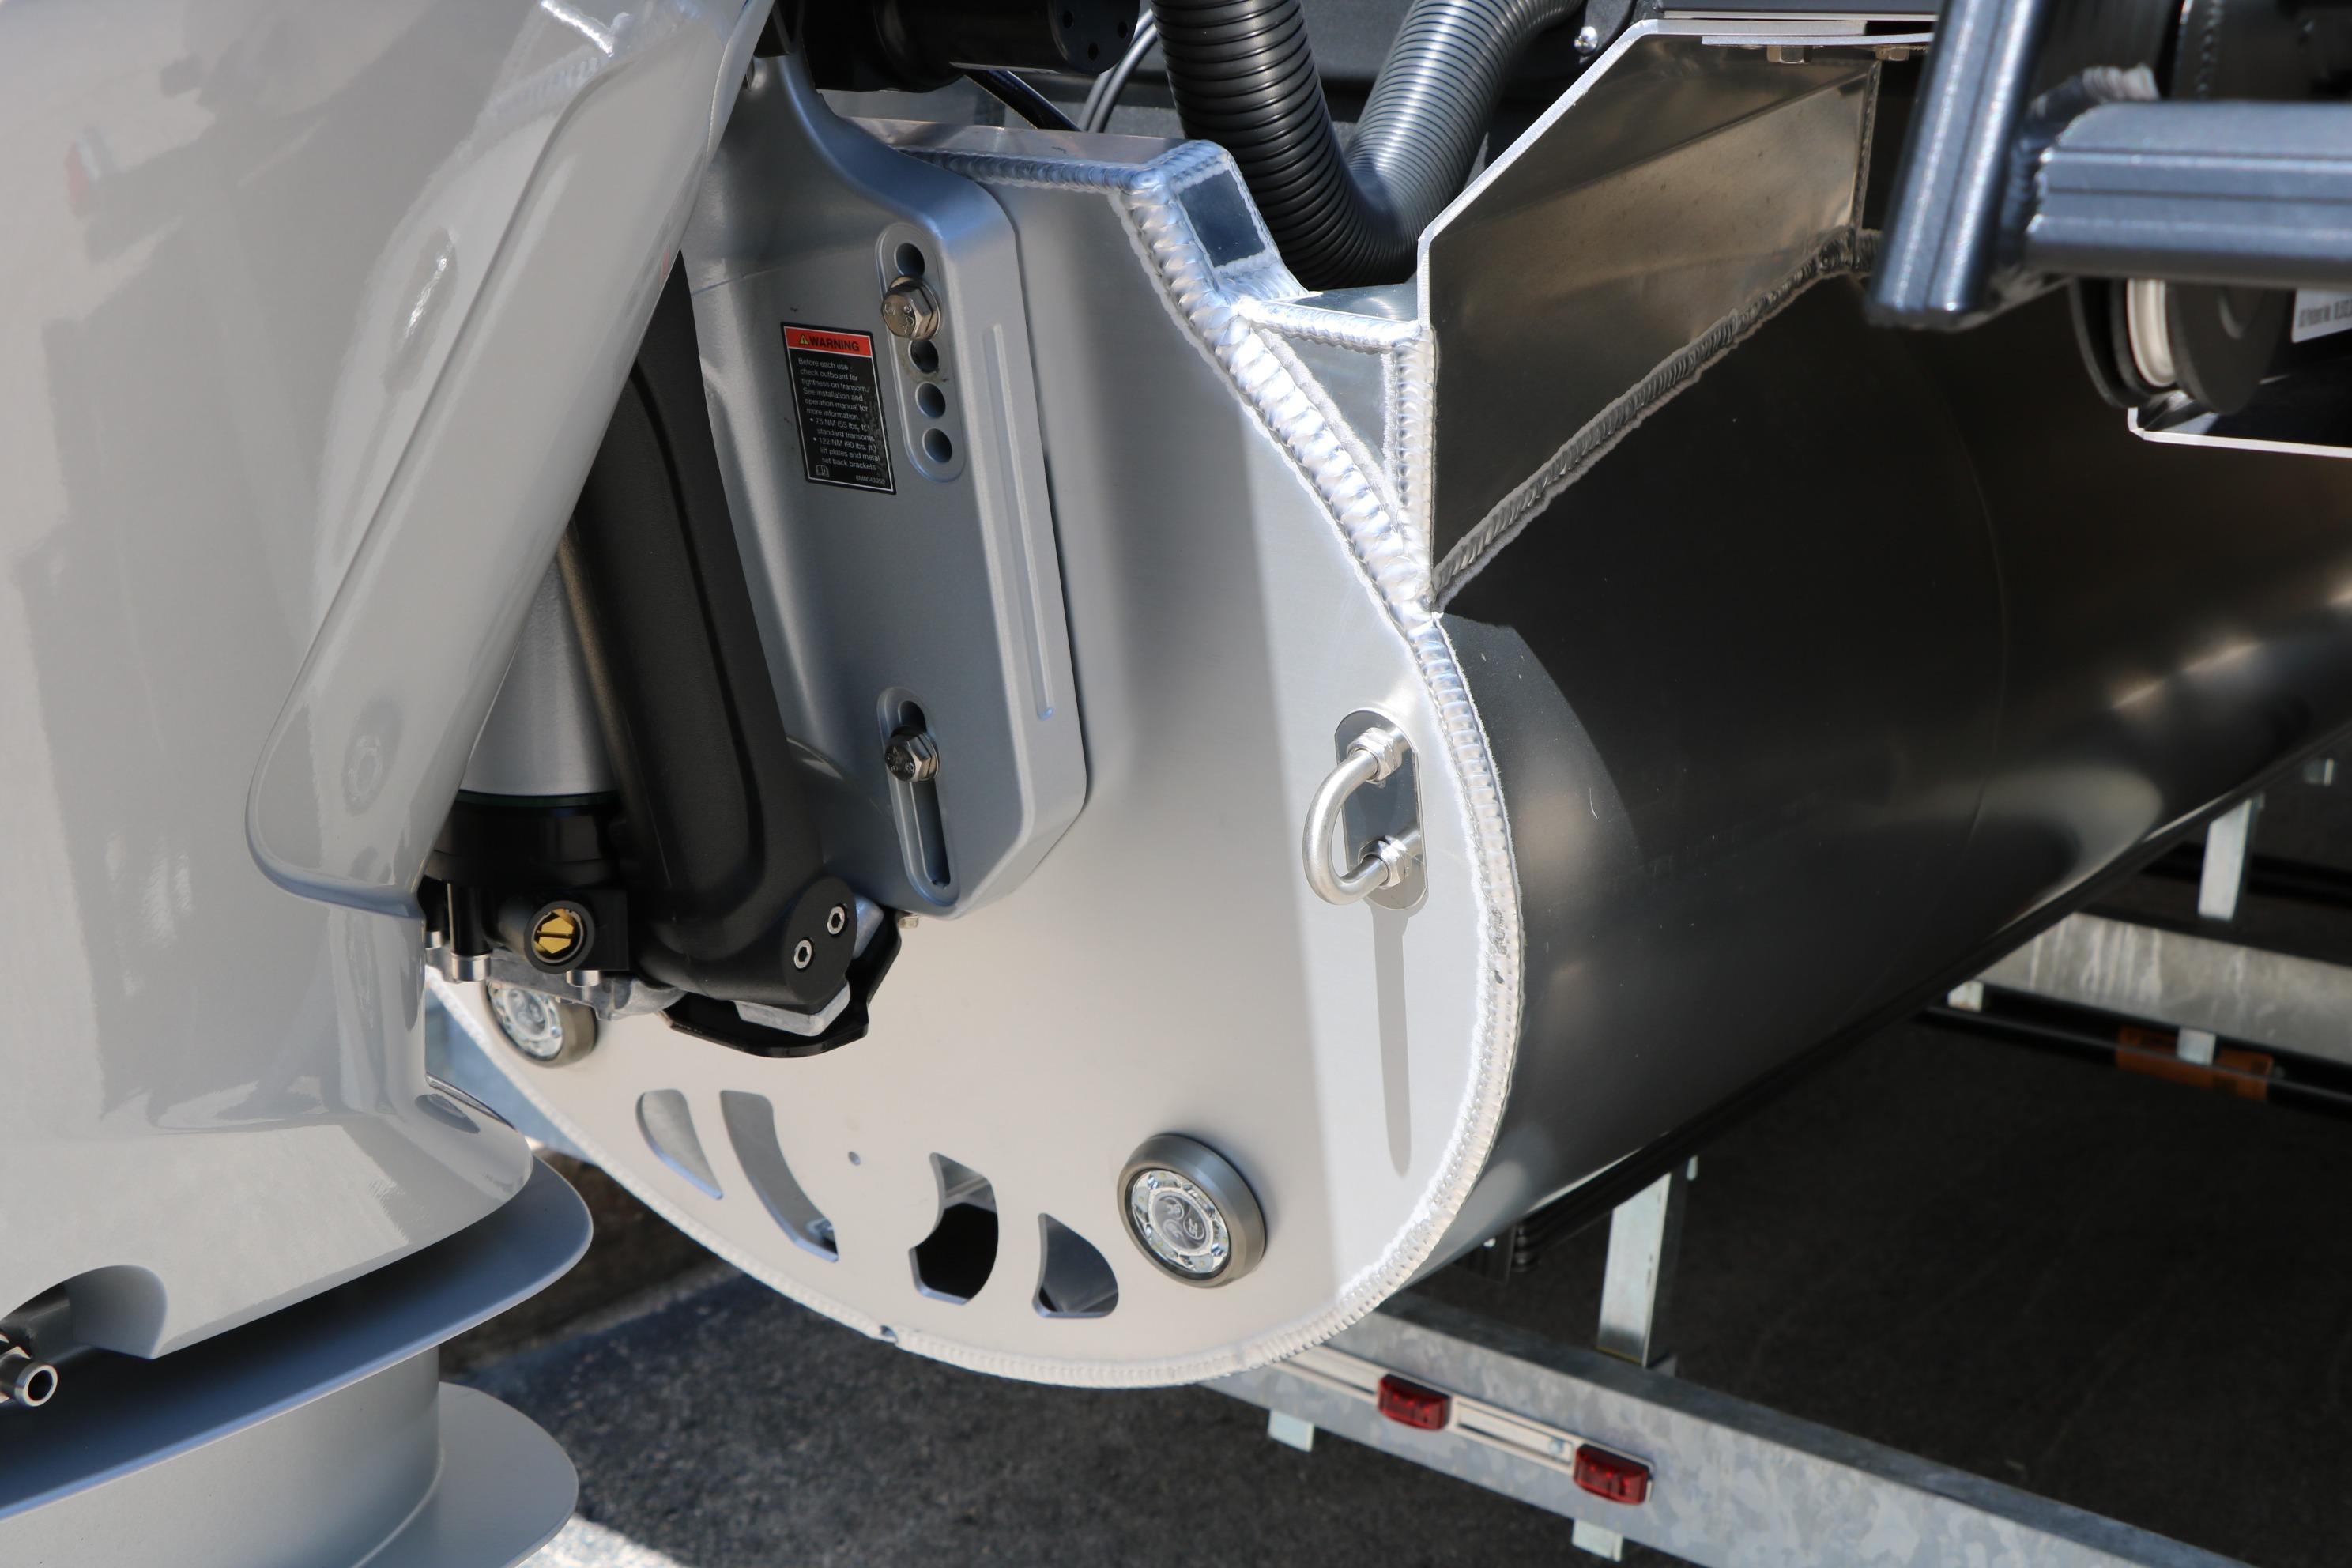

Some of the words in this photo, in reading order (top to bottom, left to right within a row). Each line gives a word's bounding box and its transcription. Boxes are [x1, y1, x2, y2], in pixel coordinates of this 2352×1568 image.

[808, 336, 860, 351] WARNING
[798, 357, 819, 367] Before
[800, 368, 818, 376] check
[820, 369, 848, 380] outboard
[801, 378, 830, 388] tightness
[816, 389, 850, 399] installation
[805, 398, 834, 408] operation
[835, 401, 858, 410] manual
[817, 428, 844, 438] standard
[819, 436, 831, 445] 122
[844, 440, 854, 449] (90
[855, 442, 866, 450] lbs.
[829, 448, 848, 458] plates
[849, 450, 861, 459] and
[862, 454, 881, 462] metal
[832, 458, 848, 467] back
[849, 460, 876, 471] brackets
